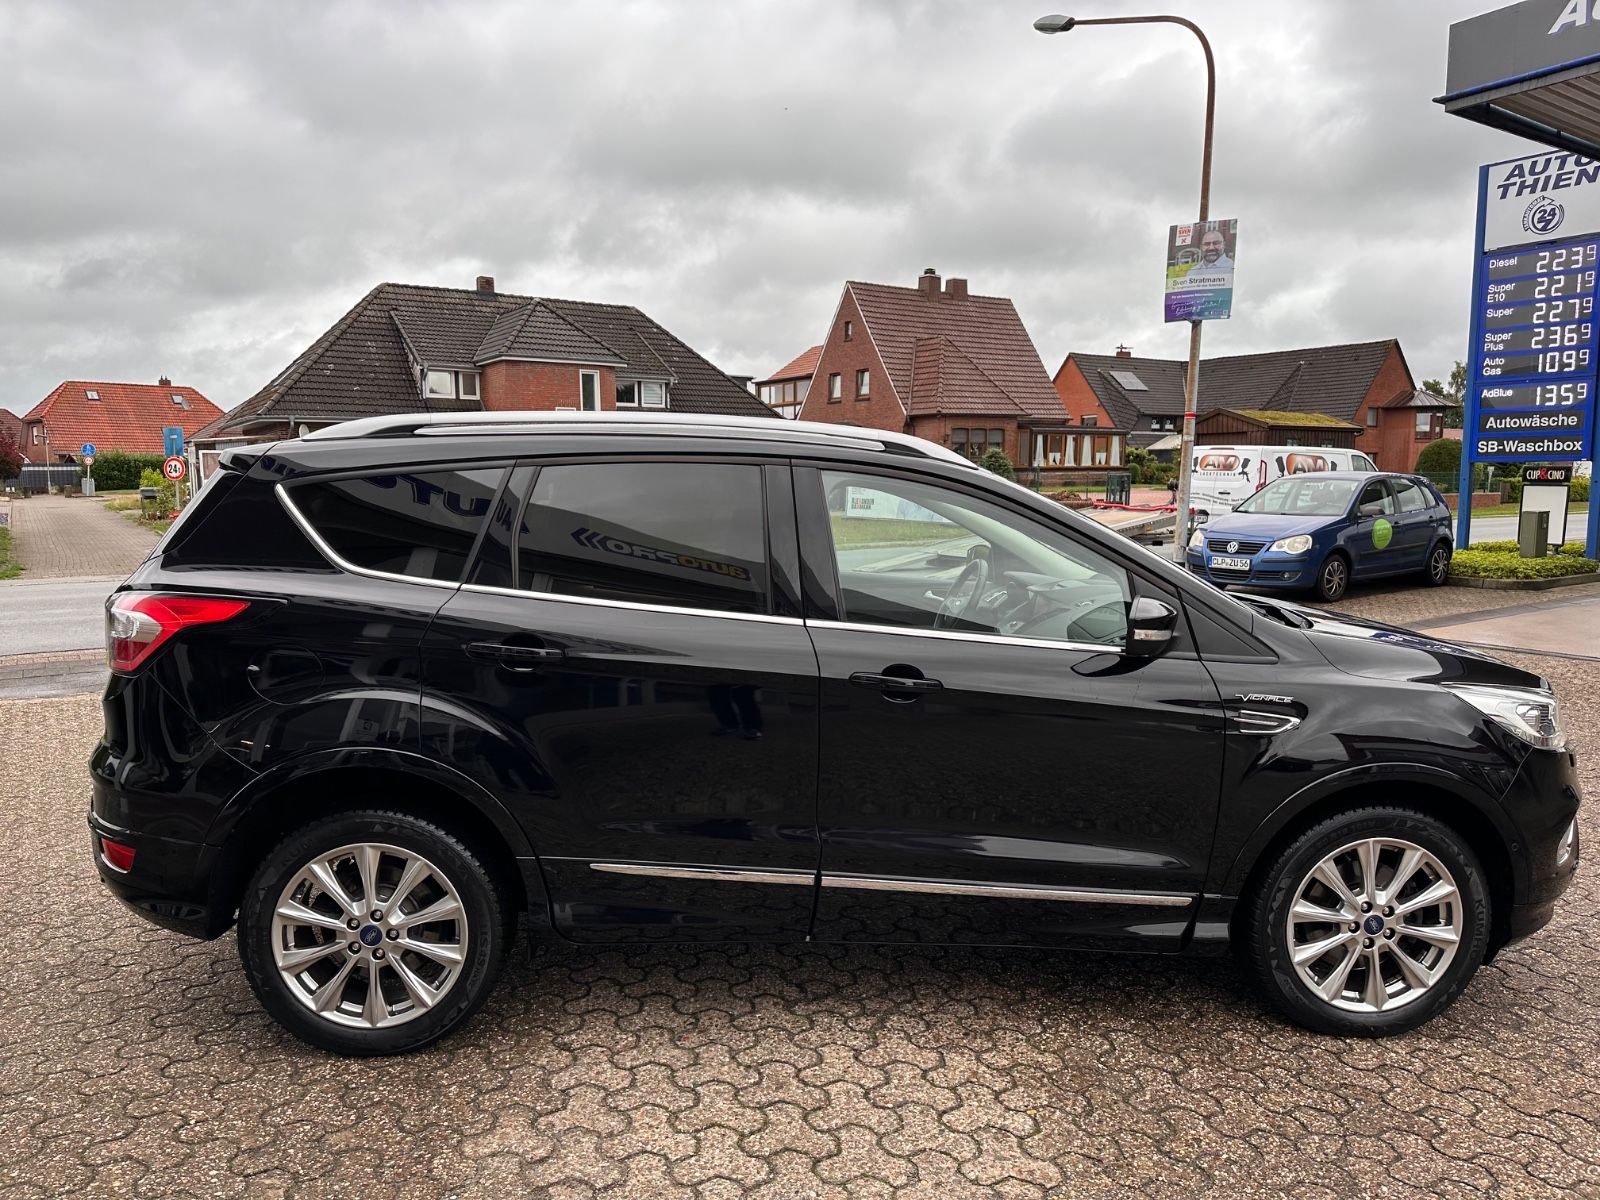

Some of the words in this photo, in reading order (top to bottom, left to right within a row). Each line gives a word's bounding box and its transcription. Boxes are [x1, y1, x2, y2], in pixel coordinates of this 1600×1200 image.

[1547, 0, 1600, 35] A
[1497, 165, 1600, 200] THIEN
[1489, 257, 1518, 269] Diesel
[1487, 283, 1516, 294] Super
[1487, 293, 1506, 303] E10
[1486, 308, 1515, 318] Super
[1485, 332, 1513, 342] Super
[1484, 342, 1504, 352] Plus
[1483, 357, 1505, 366] Auto
[1482, 367, 1502, 376] Gas
[1481, 388, 1514, 398] AdBlue
[1485, 413, 1578, 429] Autowäsche
[1477, 439, 1583, 453] SB-Waschbox
[1212, 557, 1226, 566] CLP
[1229, 559, 1239, 567] ZU
[1239, 560, 1249, 568] 56
[1235, 694, 1294, 703] VIGNALE
